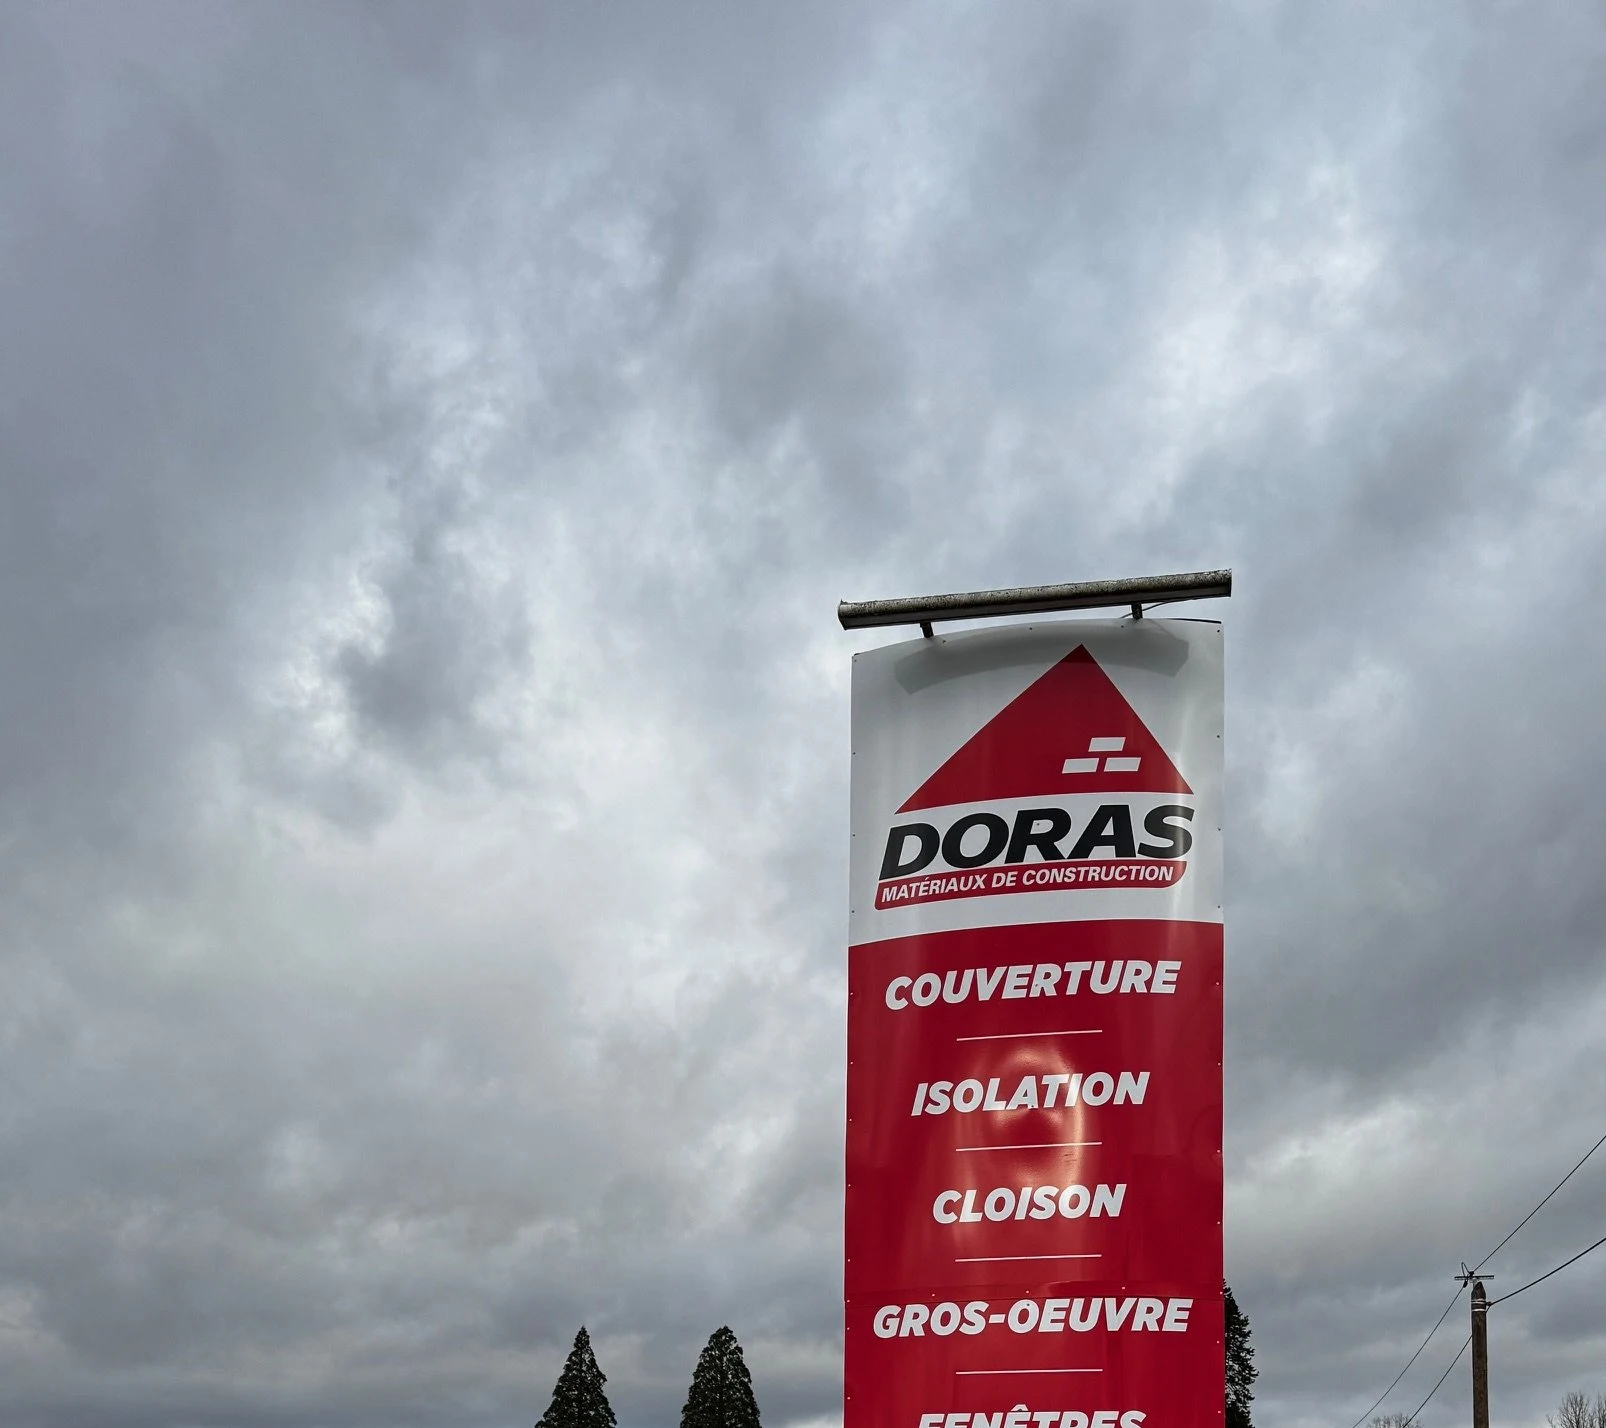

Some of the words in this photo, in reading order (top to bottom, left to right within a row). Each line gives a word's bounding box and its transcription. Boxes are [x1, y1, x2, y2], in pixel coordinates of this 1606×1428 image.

[879, 804, 1195, 879] DORAS
[881, 874, 984, 903] MATÉRIAUX
[992, 870, 1017, 888] DE
[1022, 864, 1174, 886] CONSTRUCTION
[885, 960, 1182, 1011] COUVERTURE
[911, 1072, 1151, 1117] ISOLATION
[933, 1183, 1127, 1224] CLOISON
[873, 1297, 1194, 1339] GROS-OEUVRE
